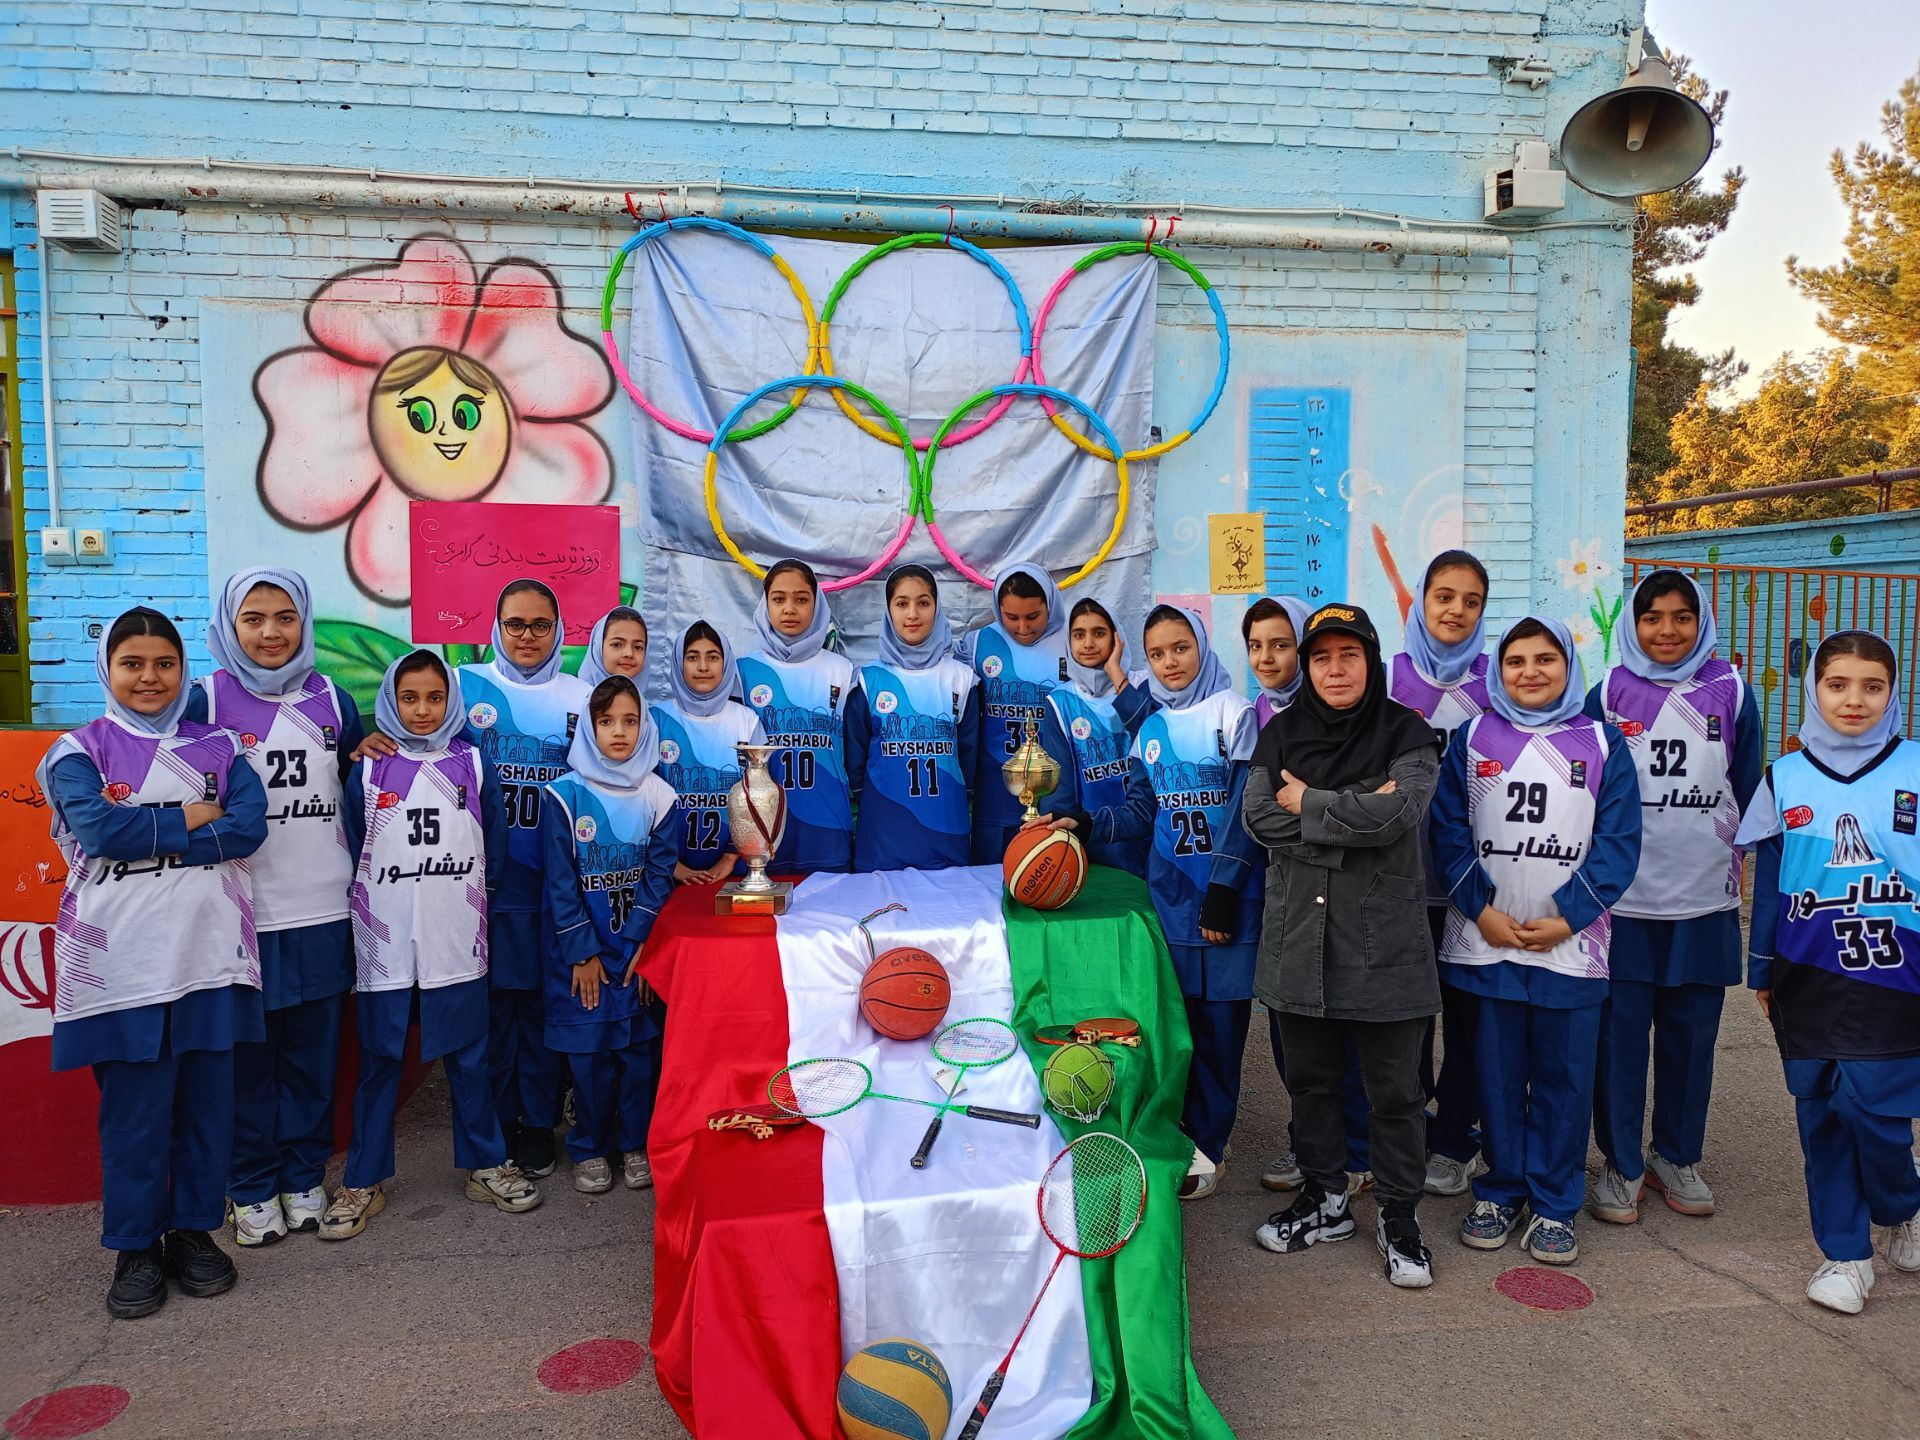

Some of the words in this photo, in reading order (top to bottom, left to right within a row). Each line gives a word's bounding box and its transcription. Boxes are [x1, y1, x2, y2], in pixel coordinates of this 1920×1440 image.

[1307, 426, 1324, 440] ۲۱۰
[1306, 533, 1321, 547] ۱۷۰
[474, 541, 524, 572] بدنی
[525, 545, 578, 580] تربیت
[570, 546, 600, 576] روز
[1306, 585, 1323, 599] ۱۵۰
[986, 703, 1046, 720] NEYSHAB
[763, 732, 834, 751] EYSHABU
[881, 740, 954, 757] NEYSHABUR
[266, 749, 307, 789] 23
[494, 762, 566, 783] YSHABUR
[780, 749, 816, 790] 10
[1081, 756, 1133, 784] NEYSHA
[1649, 739, 1687, 777] 32
[906, 756, 940, 798] 11
[265, 794, 336, 825] نیشاب
[500, 781, 540, 829] 30
[676, 792, 728, 810] YSHAB
[1155, 789, 1228, 811] EYSHABUR
[1505, 781, 1547, 824] 29
[1640, 785, 1722, 814] نیشاب
[406, 807, 441, 847] 35
[685, 809, 722, 850] 12
[1170, 809, 1213, 857] 29
[1896, 814, 1914, 824] FIBA
[1477, 833, 1583, 867] نیشابو
[376, 852, 475, 886] نیشابور
[579, 865, 645, 892] NEYSHAB
[1022, 855, 1054, 897] molden
[1786, 867, 1920, 923] شابور
[1832, 917, 1904, 970] 33
[922, 982, 931, 995] 5
